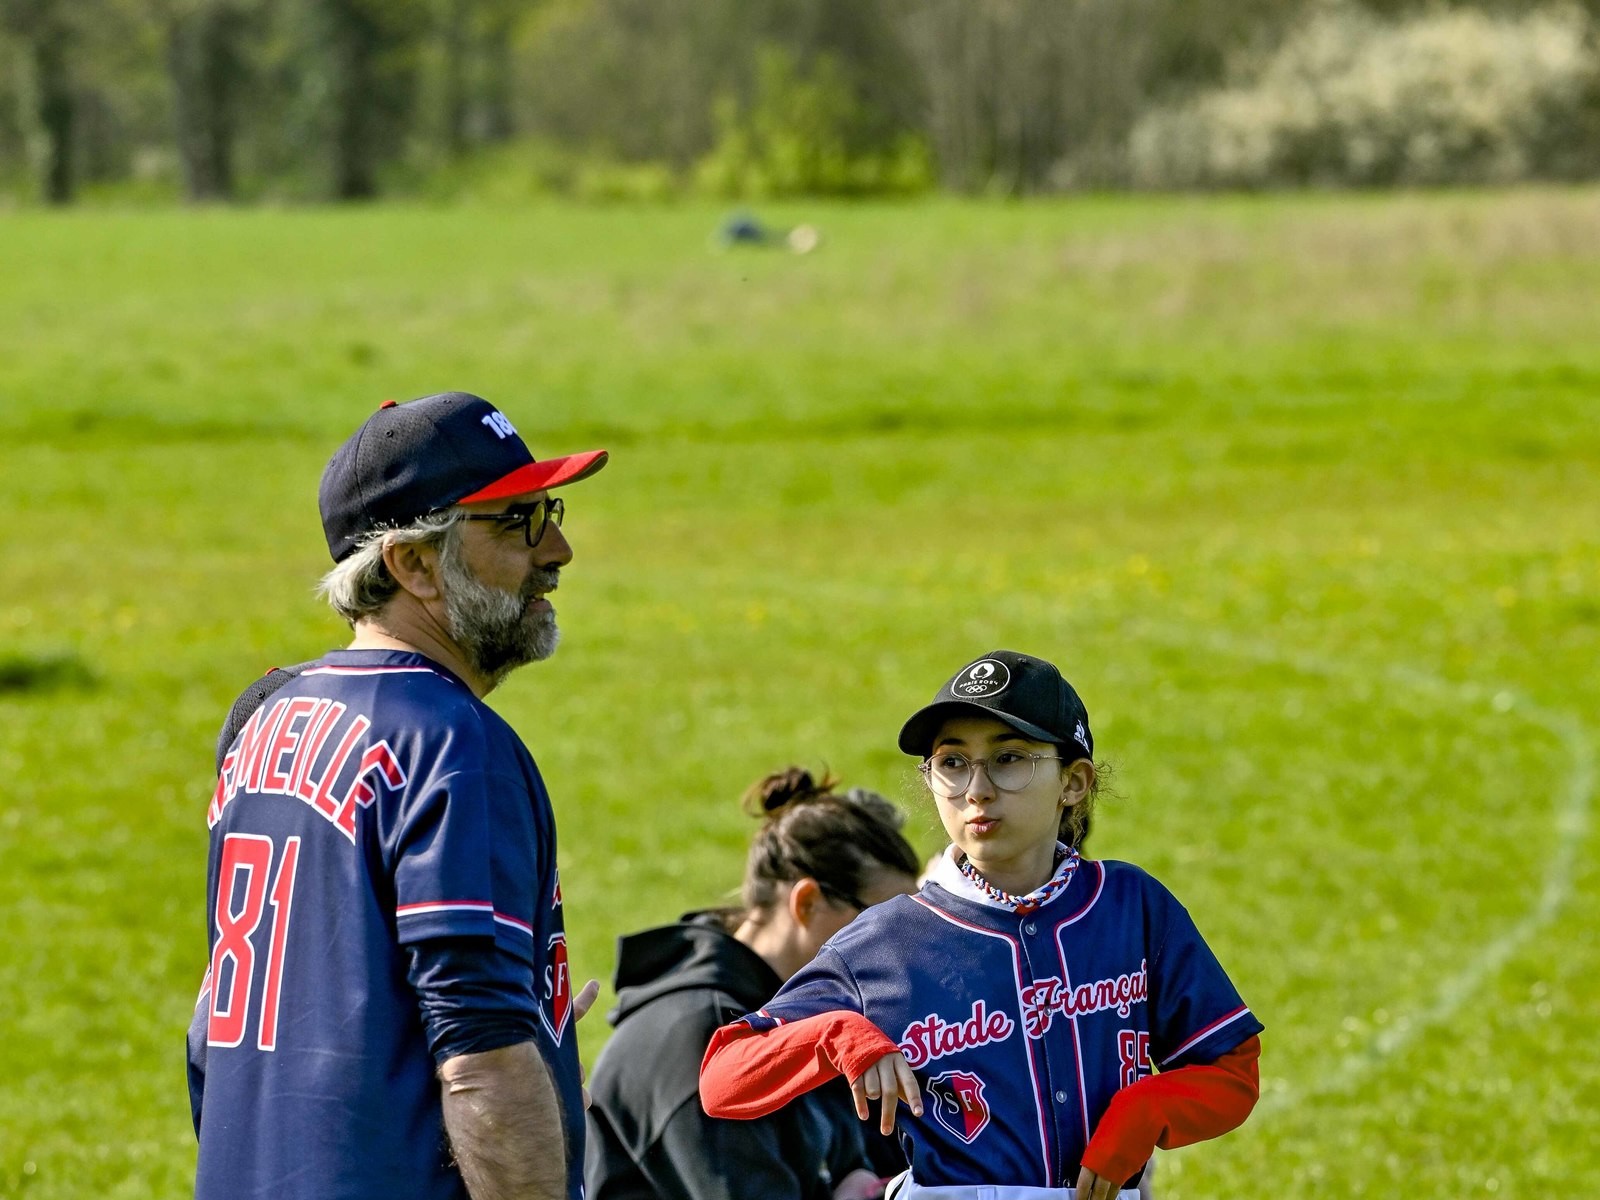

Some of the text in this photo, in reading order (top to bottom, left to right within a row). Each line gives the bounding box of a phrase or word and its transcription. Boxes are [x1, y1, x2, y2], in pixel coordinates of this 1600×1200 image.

[481, 410, 518, 440] 18
[207, 832, 301, 1052] 81
[897, 999, 1015, 1071] Stade
[943, 1089, 973, 1115] SF
